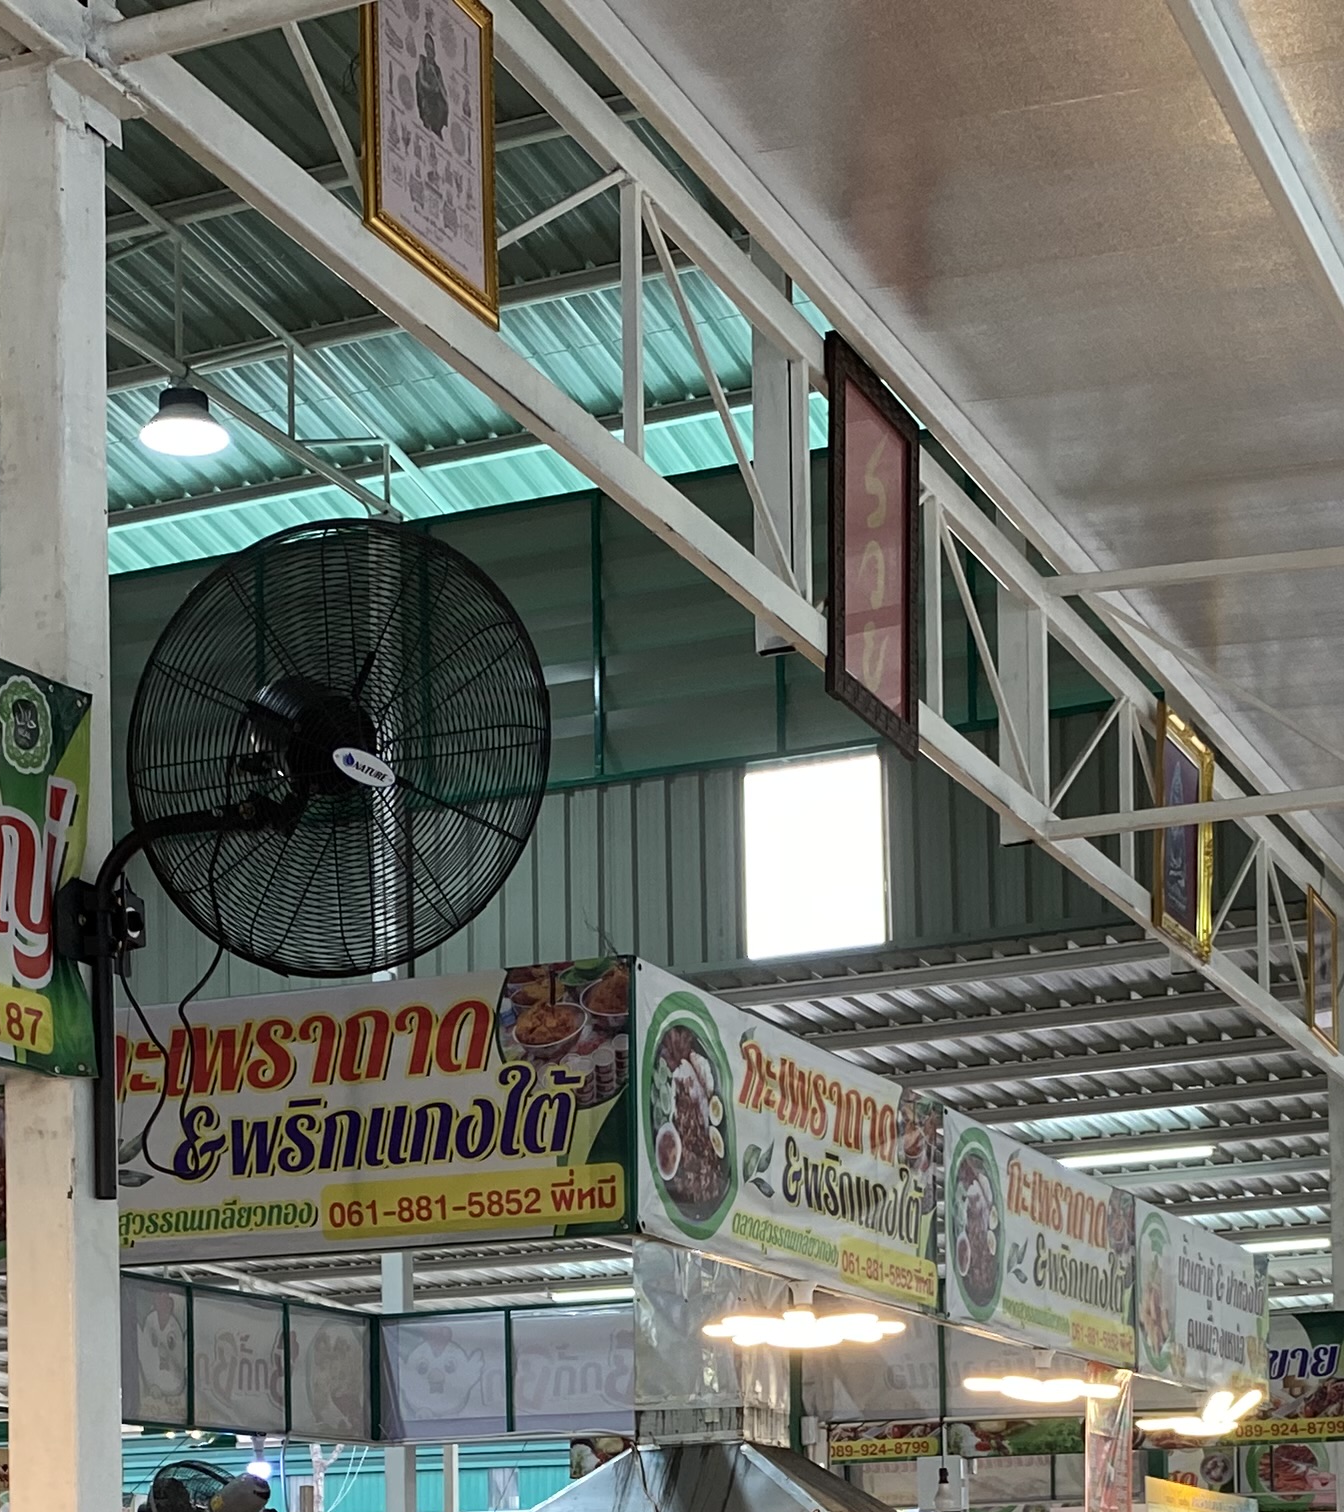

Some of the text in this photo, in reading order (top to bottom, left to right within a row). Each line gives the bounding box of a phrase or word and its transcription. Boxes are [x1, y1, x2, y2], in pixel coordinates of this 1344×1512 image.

[352, 760, 389, 783] NATURE
[117, 999, 496, 1103] ะเพราถาด
[327, 1188, 542, 1230] 061-881-5852
[842, 1249, 913, 1290] 061-881-5852
[830, 1440, 930, 1458] 089-924-8799
